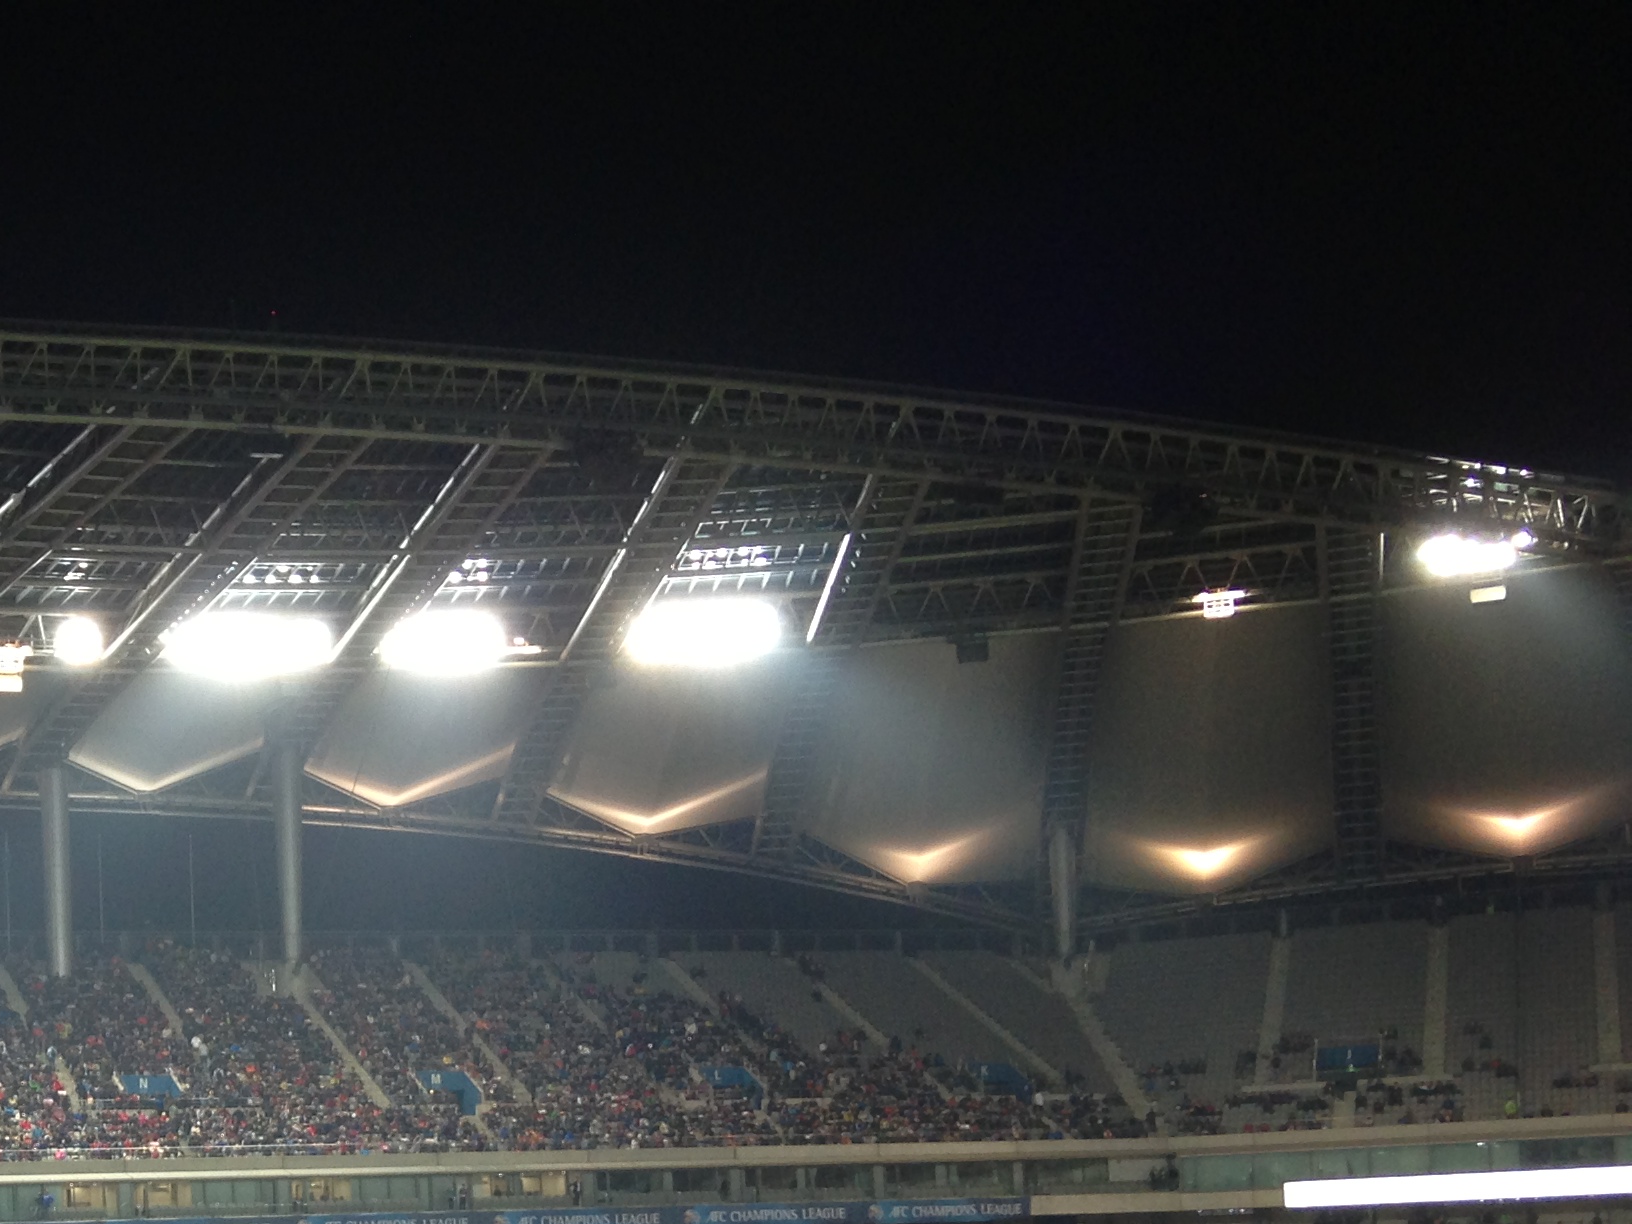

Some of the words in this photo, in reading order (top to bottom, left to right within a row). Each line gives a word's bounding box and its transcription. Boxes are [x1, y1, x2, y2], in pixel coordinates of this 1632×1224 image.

[139, 1077, 148, 1089] N
[706, 1211, 727, 1224] AFC
[730, 1208, 798, 1223] CHAMPIONS
[802, 1205, 847, 1221] LEAGUE
[981, 1202, 1023, 1216] LEAGUE
[615, 1211, 661, 1224] LEAGUE
